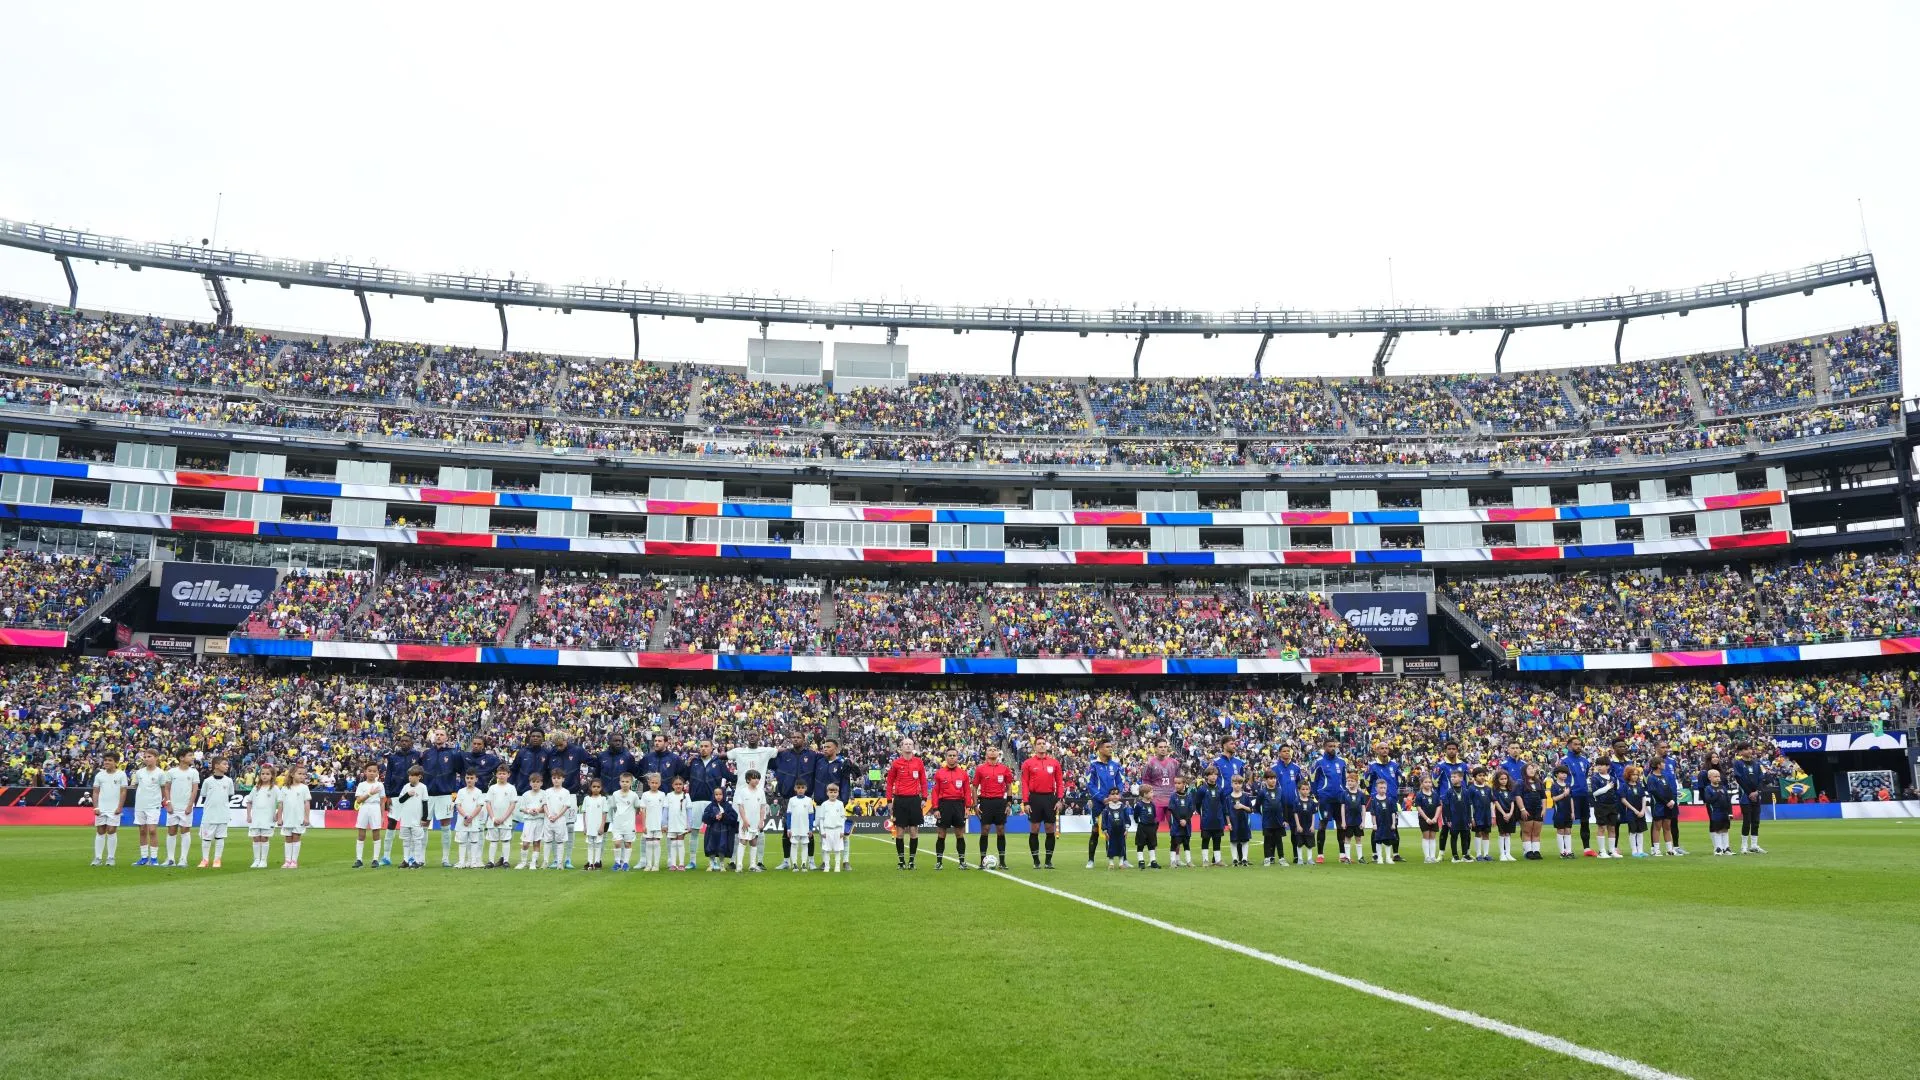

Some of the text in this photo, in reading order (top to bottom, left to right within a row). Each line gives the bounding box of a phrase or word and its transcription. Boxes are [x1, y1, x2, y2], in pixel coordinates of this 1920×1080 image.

[172, 580, 262, 604] Gillette
[1344, 606, 1418, 626] Gillette
[1162, 778, 1170, 786] 23
